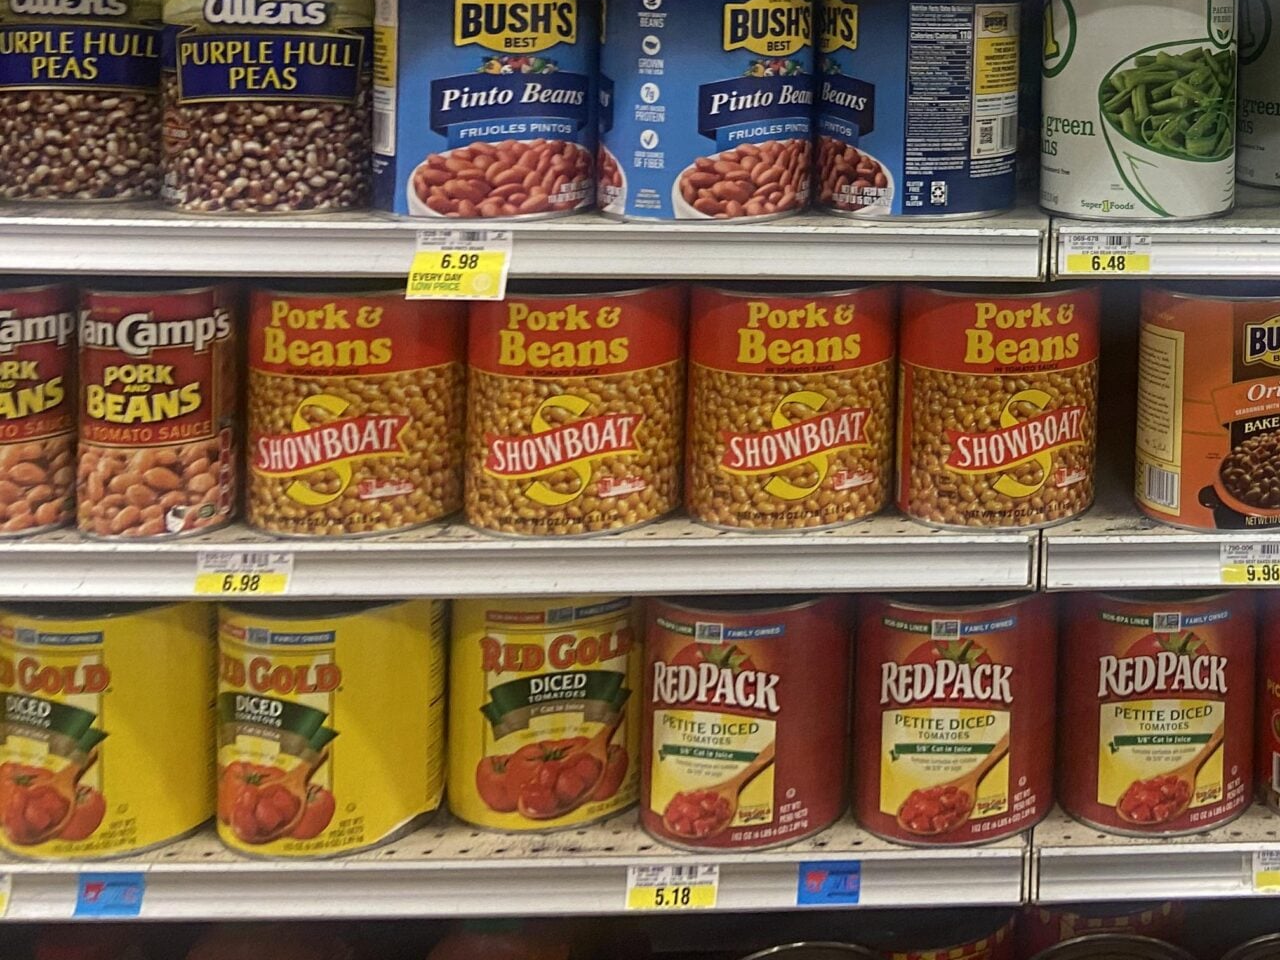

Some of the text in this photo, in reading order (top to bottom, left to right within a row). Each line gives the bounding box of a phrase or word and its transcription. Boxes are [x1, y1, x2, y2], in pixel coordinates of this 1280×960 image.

[462, 2, 575, 38] BUSH'S
[84, 35, 159, 59] HULL
[181, 41, 355, 68] PURPLE HULL
[504, 37, 538, 49] BEST
[32, 57, 98, 80] PEAS
[229, 67, 297, 91] PEAS
[441, 82, 584, 112] Pinto Beans
[710, 88, 773, 116] Pinto
[822, 82, 867, 111] Beans
[460, 123, 572, 139] FRIJOLES PINTOS
[729, 123, 782, 141] FRIJOLES
[1046, 115, 1095, 139] green
[441, 254, 479, 270] 6.98
[1091, 256, 1126, 271] 6.48
[412, 273, 462, 282] EVERY DAY
[272, 300, 384, 330] Pork &
[747, 302, 855, 329] Pork &
[263, 327, 392, 368] Beans
[104, 364, 174, 387] PORK
[87, 382, 202, 424] BEANS
[159, 421, 210, 440] SAUCE
[730, 411, 866, 469] SHOWBOAT
[957, 410, 1082, 469] SHOWBOAT
[258, 416, 399, 470] SHOWBOAT
[222, 575, 260, 591] 6.98
[1247, 565, 1280, 582] 9.98
[480, 627, 634, 675] RED GOLD
[18, 657, 110, 694] GOLD
[236, 695, 283, 717] DICED
[528, 690, 586, 703] TOMATOES
[662, 714, 760, 736] PETITE DICED
[654, 888, 690, 906] 5.18
